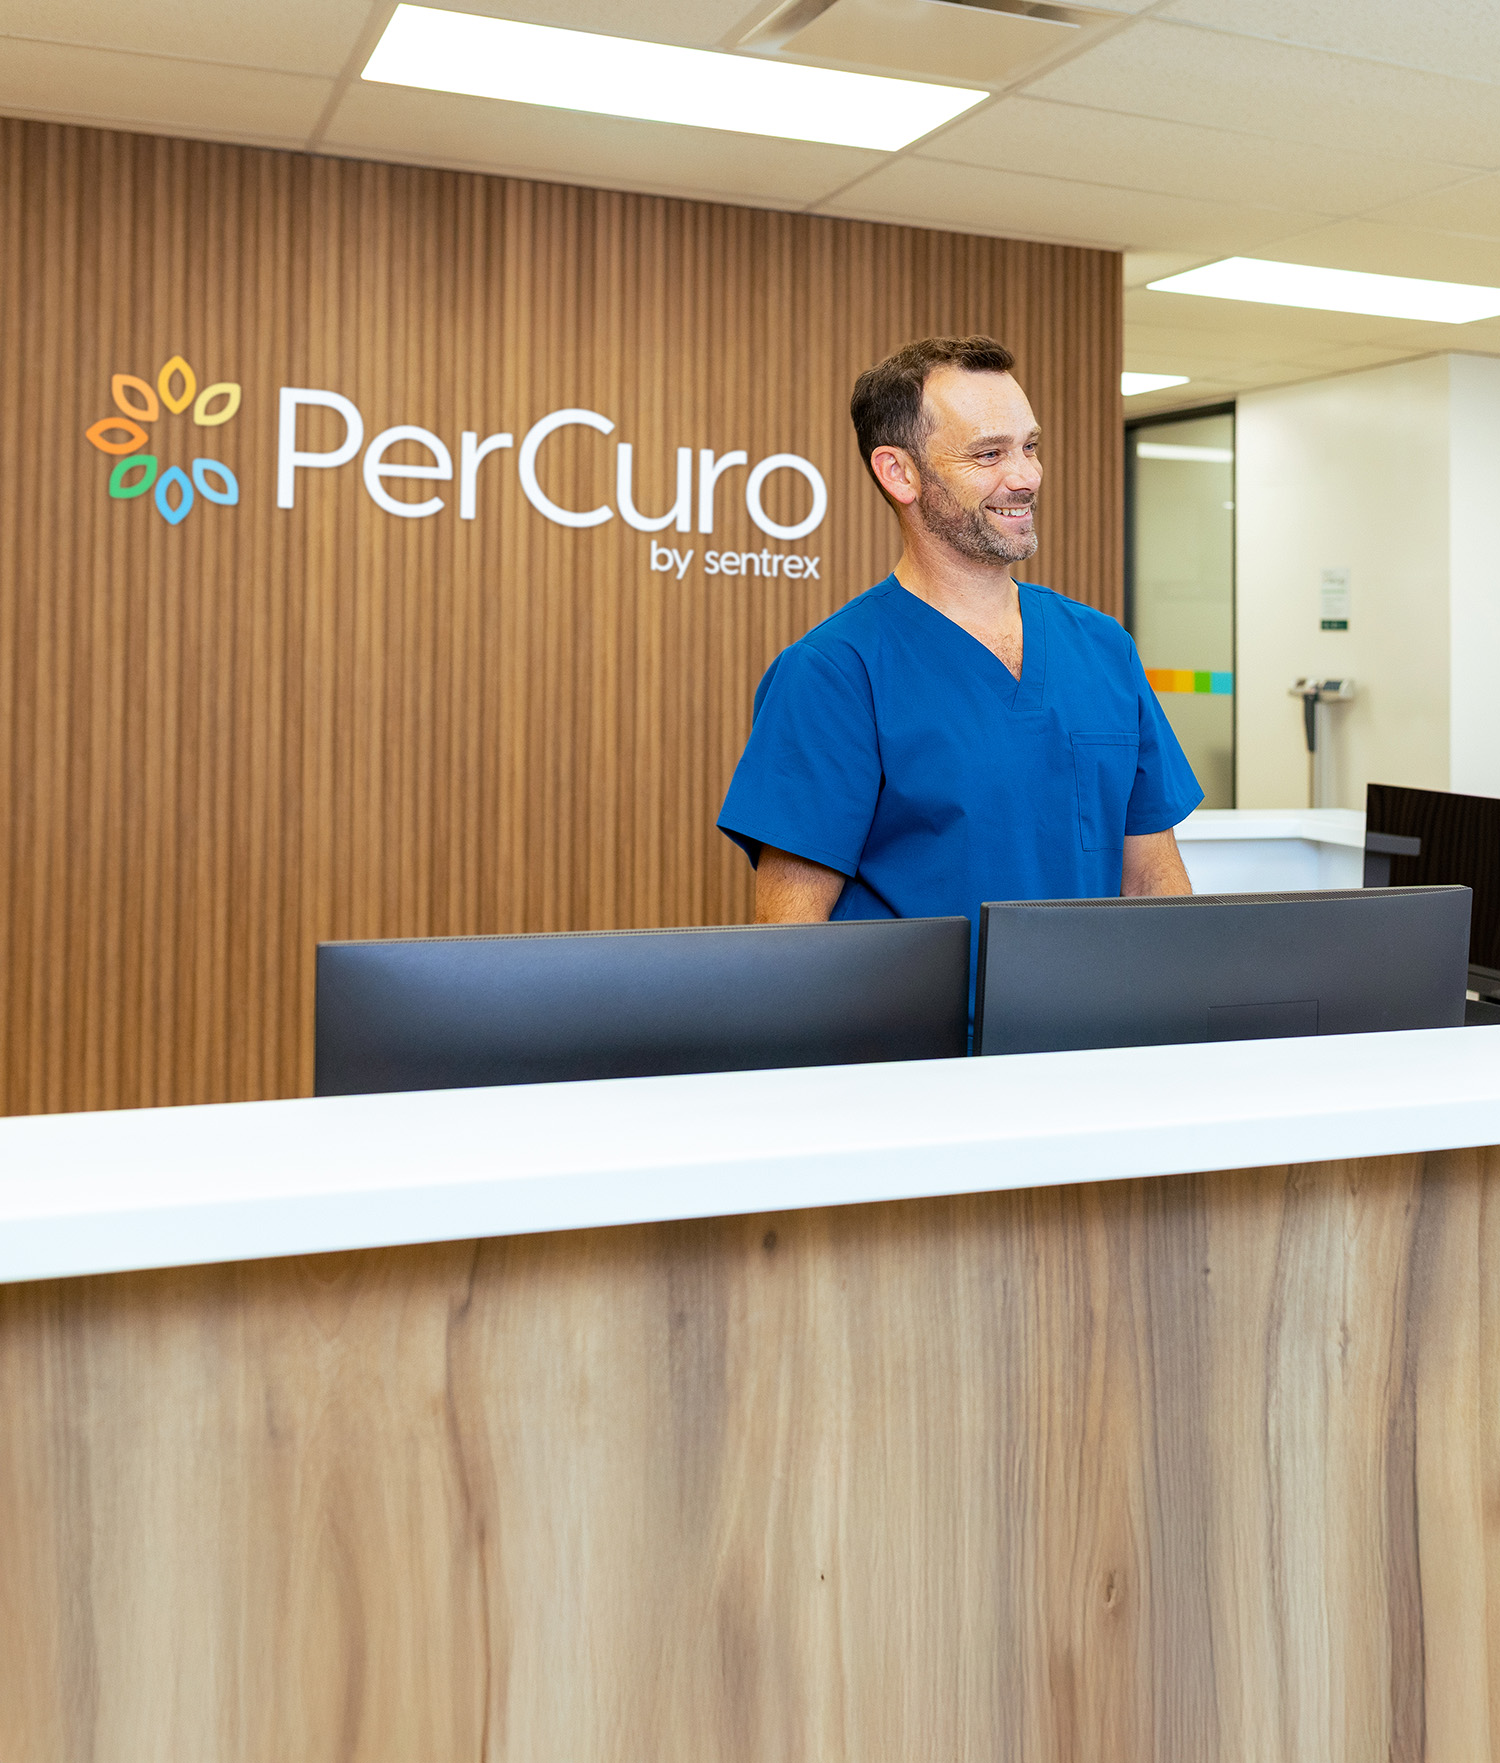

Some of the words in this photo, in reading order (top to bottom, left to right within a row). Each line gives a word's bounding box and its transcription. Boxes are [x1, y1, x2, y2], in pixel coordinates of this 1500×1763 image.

[277, 386, 828, 540] PerCuro
[650, 540, 694, 580] by
[704, 547, 820, 579] sentrex
